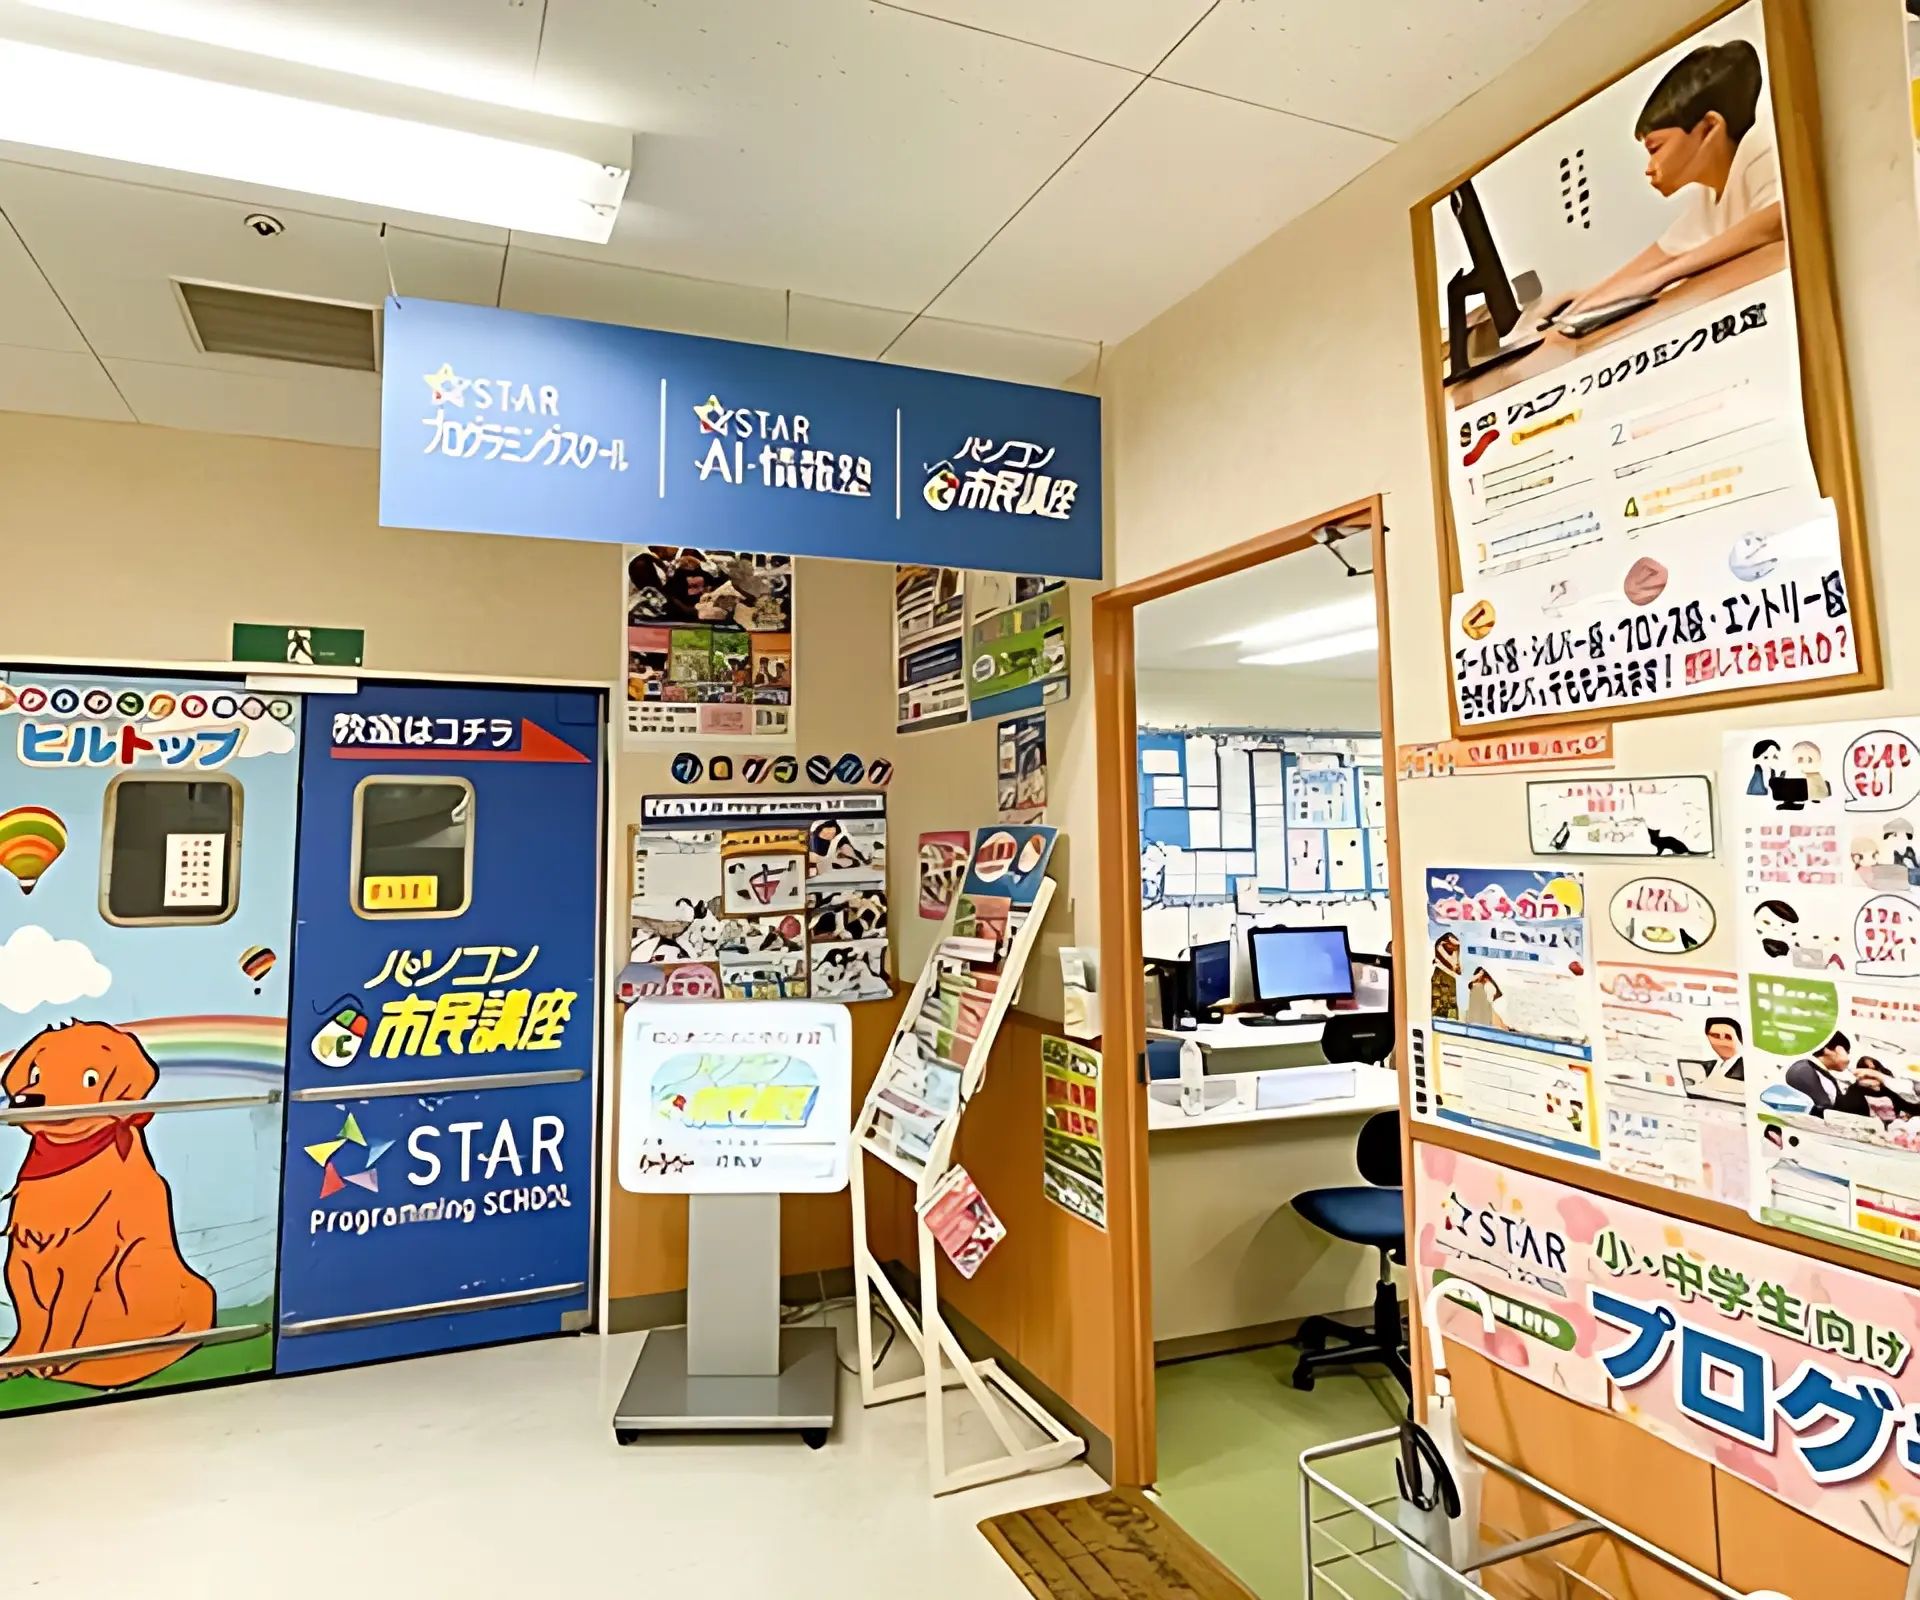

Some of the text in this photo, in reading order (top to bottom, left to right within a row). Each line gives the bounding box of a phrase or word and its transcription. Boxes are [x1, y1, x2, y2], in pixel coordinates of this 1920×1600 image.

[471, 378, 560, 417] STAR
[734, 407, 810, 445] STAR
[363, 944, 540, 990] パソコン
[369, 988, 578, 1060] 市民講座
[407, 1114, 565, 1187] STAR
[1478, 1209, 1568, 1274] STAR
[1595, 1230, 1905, 1369] 小・中学生向け
